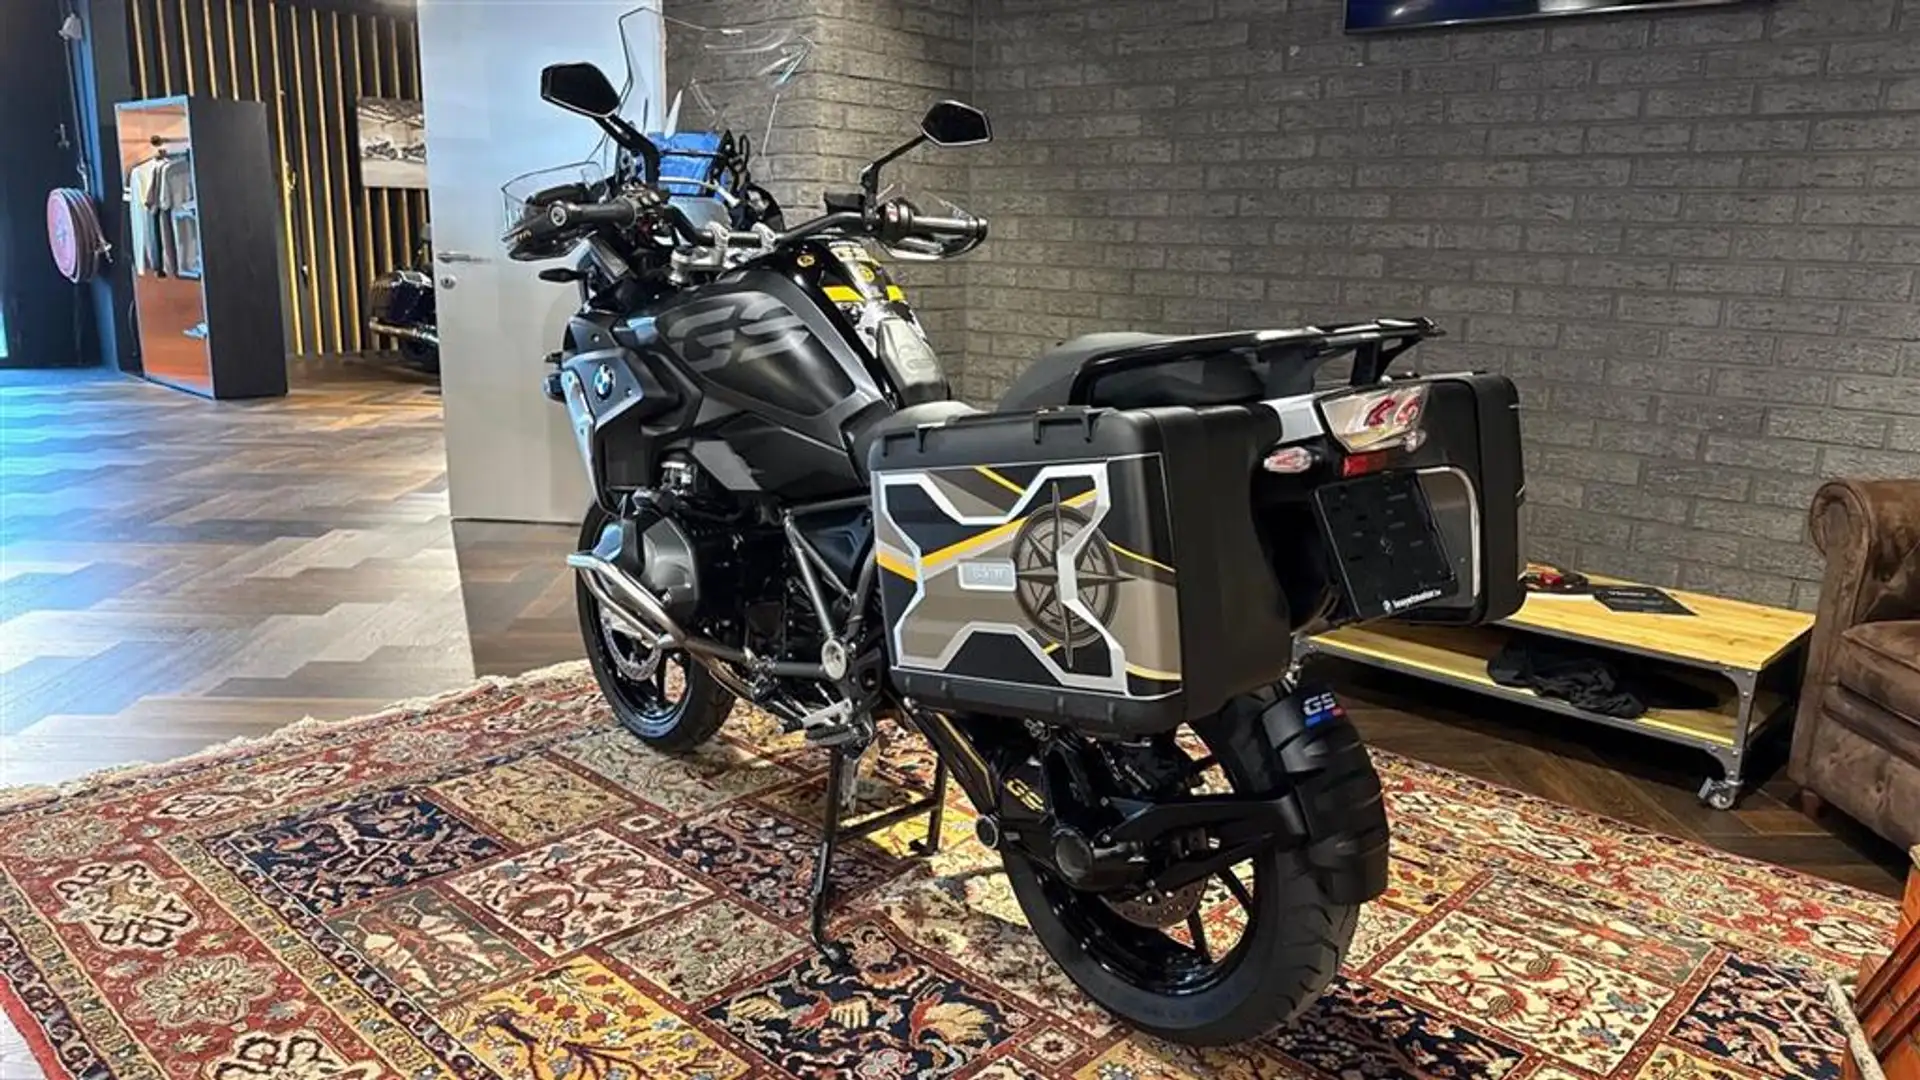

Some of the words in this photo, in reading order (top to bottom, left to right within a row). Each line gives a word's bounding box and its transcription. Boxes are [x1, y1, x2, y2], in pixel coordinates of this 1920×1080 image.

[667, 293, 810, 373] GS
[1303, 692, 1336, 716] GS
[1006, 778, 1044, 811] GS
